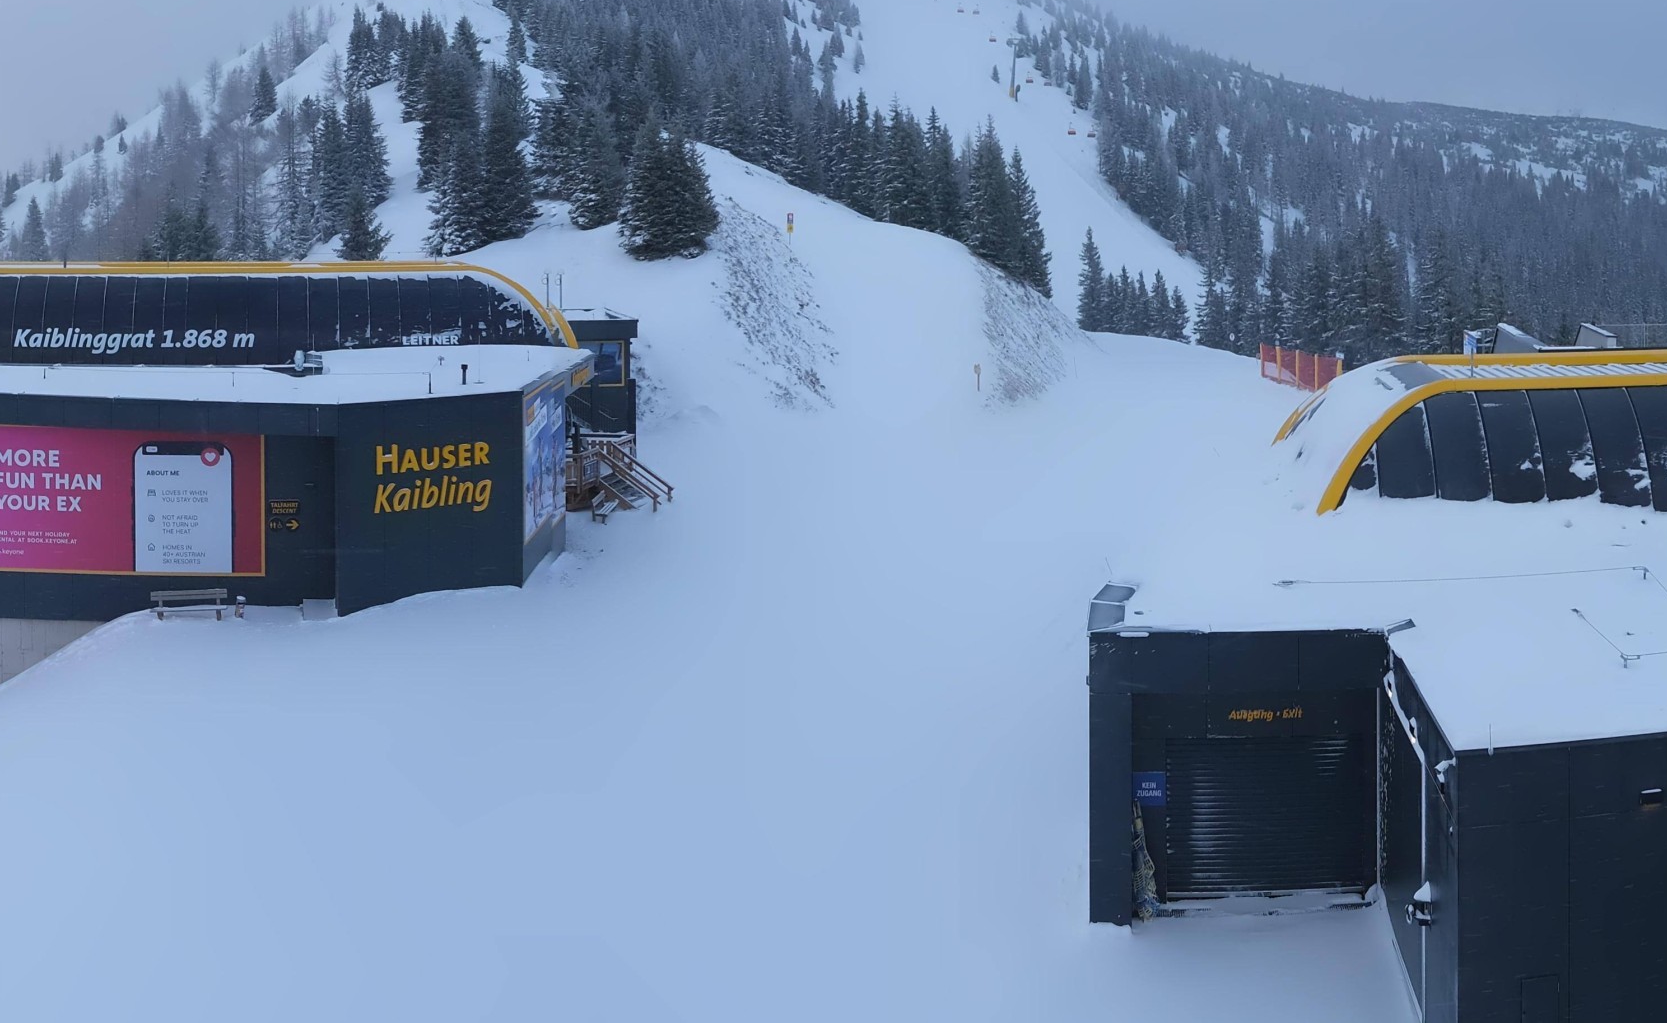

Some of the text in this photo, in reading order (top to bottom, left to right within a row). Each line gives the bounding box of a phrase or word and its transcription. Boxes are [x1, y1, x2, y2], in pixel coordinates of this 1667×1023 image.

[13, 327, 255, 354] Kaiblinggrat 1.868 m
[402, 335, 460, 346] LEITNER
[375, 441, 490, 475] HAUSER
[41, 472, 102, 491] THAN
[56, 495, 82, 512] EX
[374, 475, 492, 514] Kaibling
[1136, 789, 1162, 797] ZUGANG
